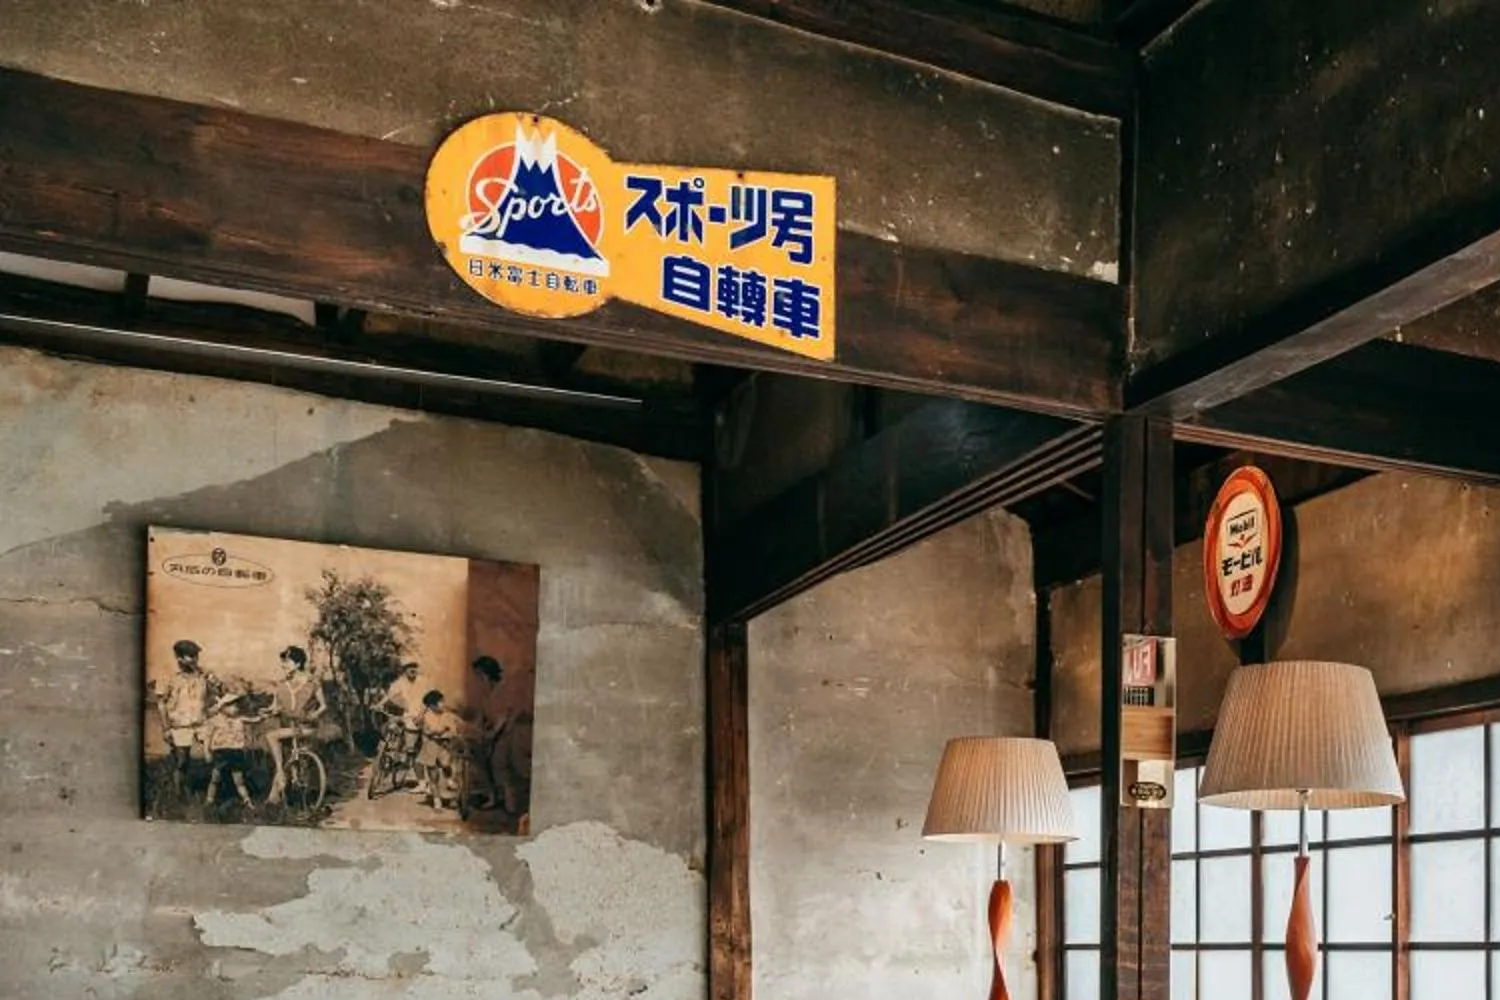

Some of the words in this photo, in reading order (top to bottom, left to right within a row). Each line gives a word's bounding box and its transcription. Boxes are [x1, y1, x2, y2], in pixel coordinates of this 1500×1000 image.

[459, 169, 597, 238] Sports
[625, 175, 814, 264] スポーツ号
[662, 256, 821, 339] 自轉車
[1222, 546, 1263, 577] モービル
